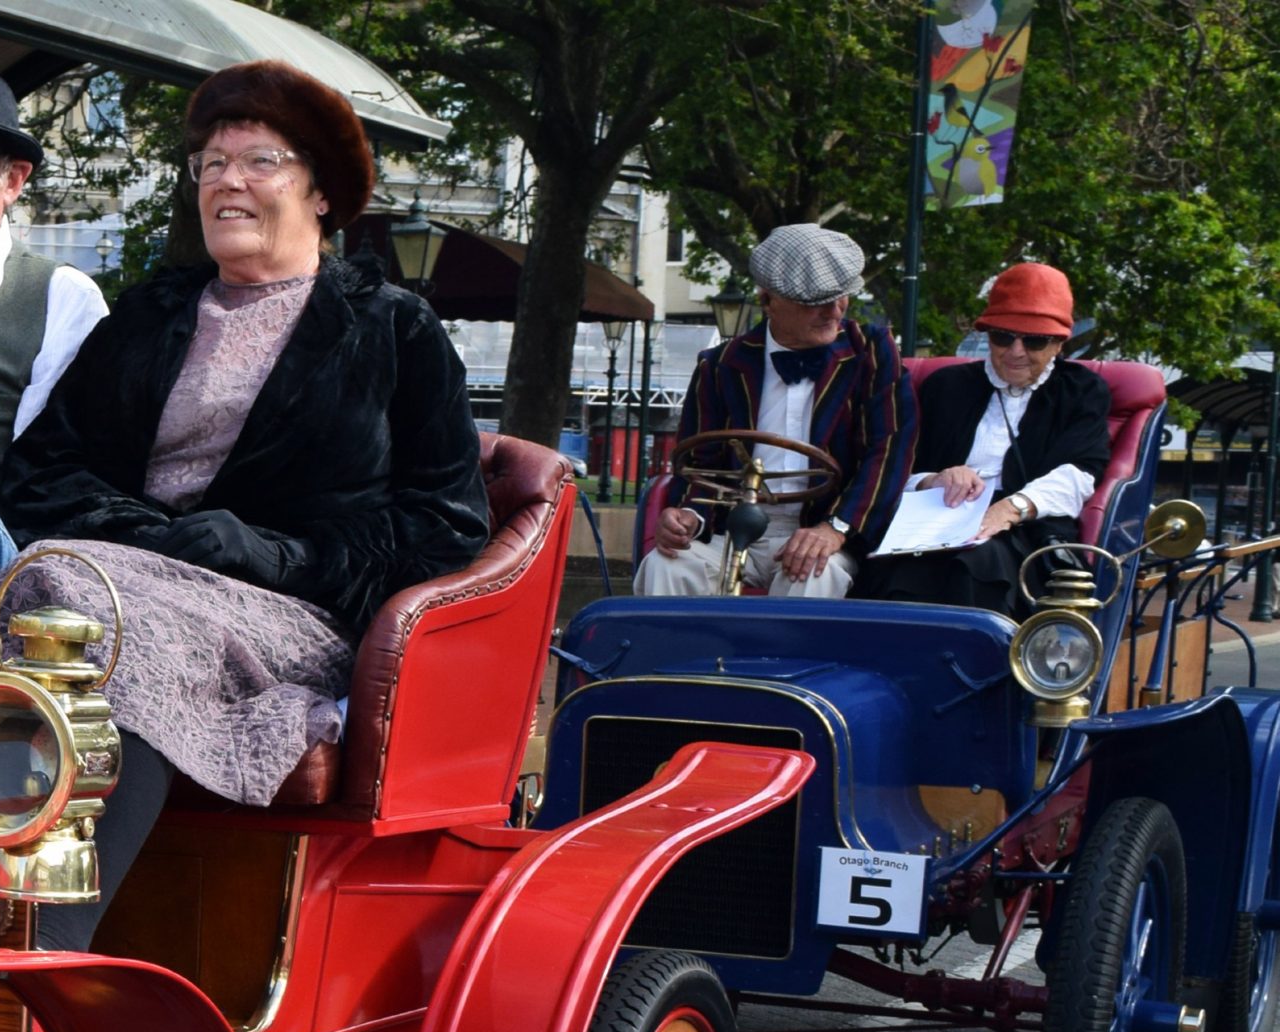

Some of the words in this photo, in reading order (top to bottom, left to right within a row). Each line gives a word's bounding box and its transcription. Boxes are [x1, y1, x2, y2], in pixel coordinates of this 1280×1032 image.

[839, 856, 870, 866] Otago
[872, 857, 909, 871] Branch
[848, 875, 892, 927] 5
